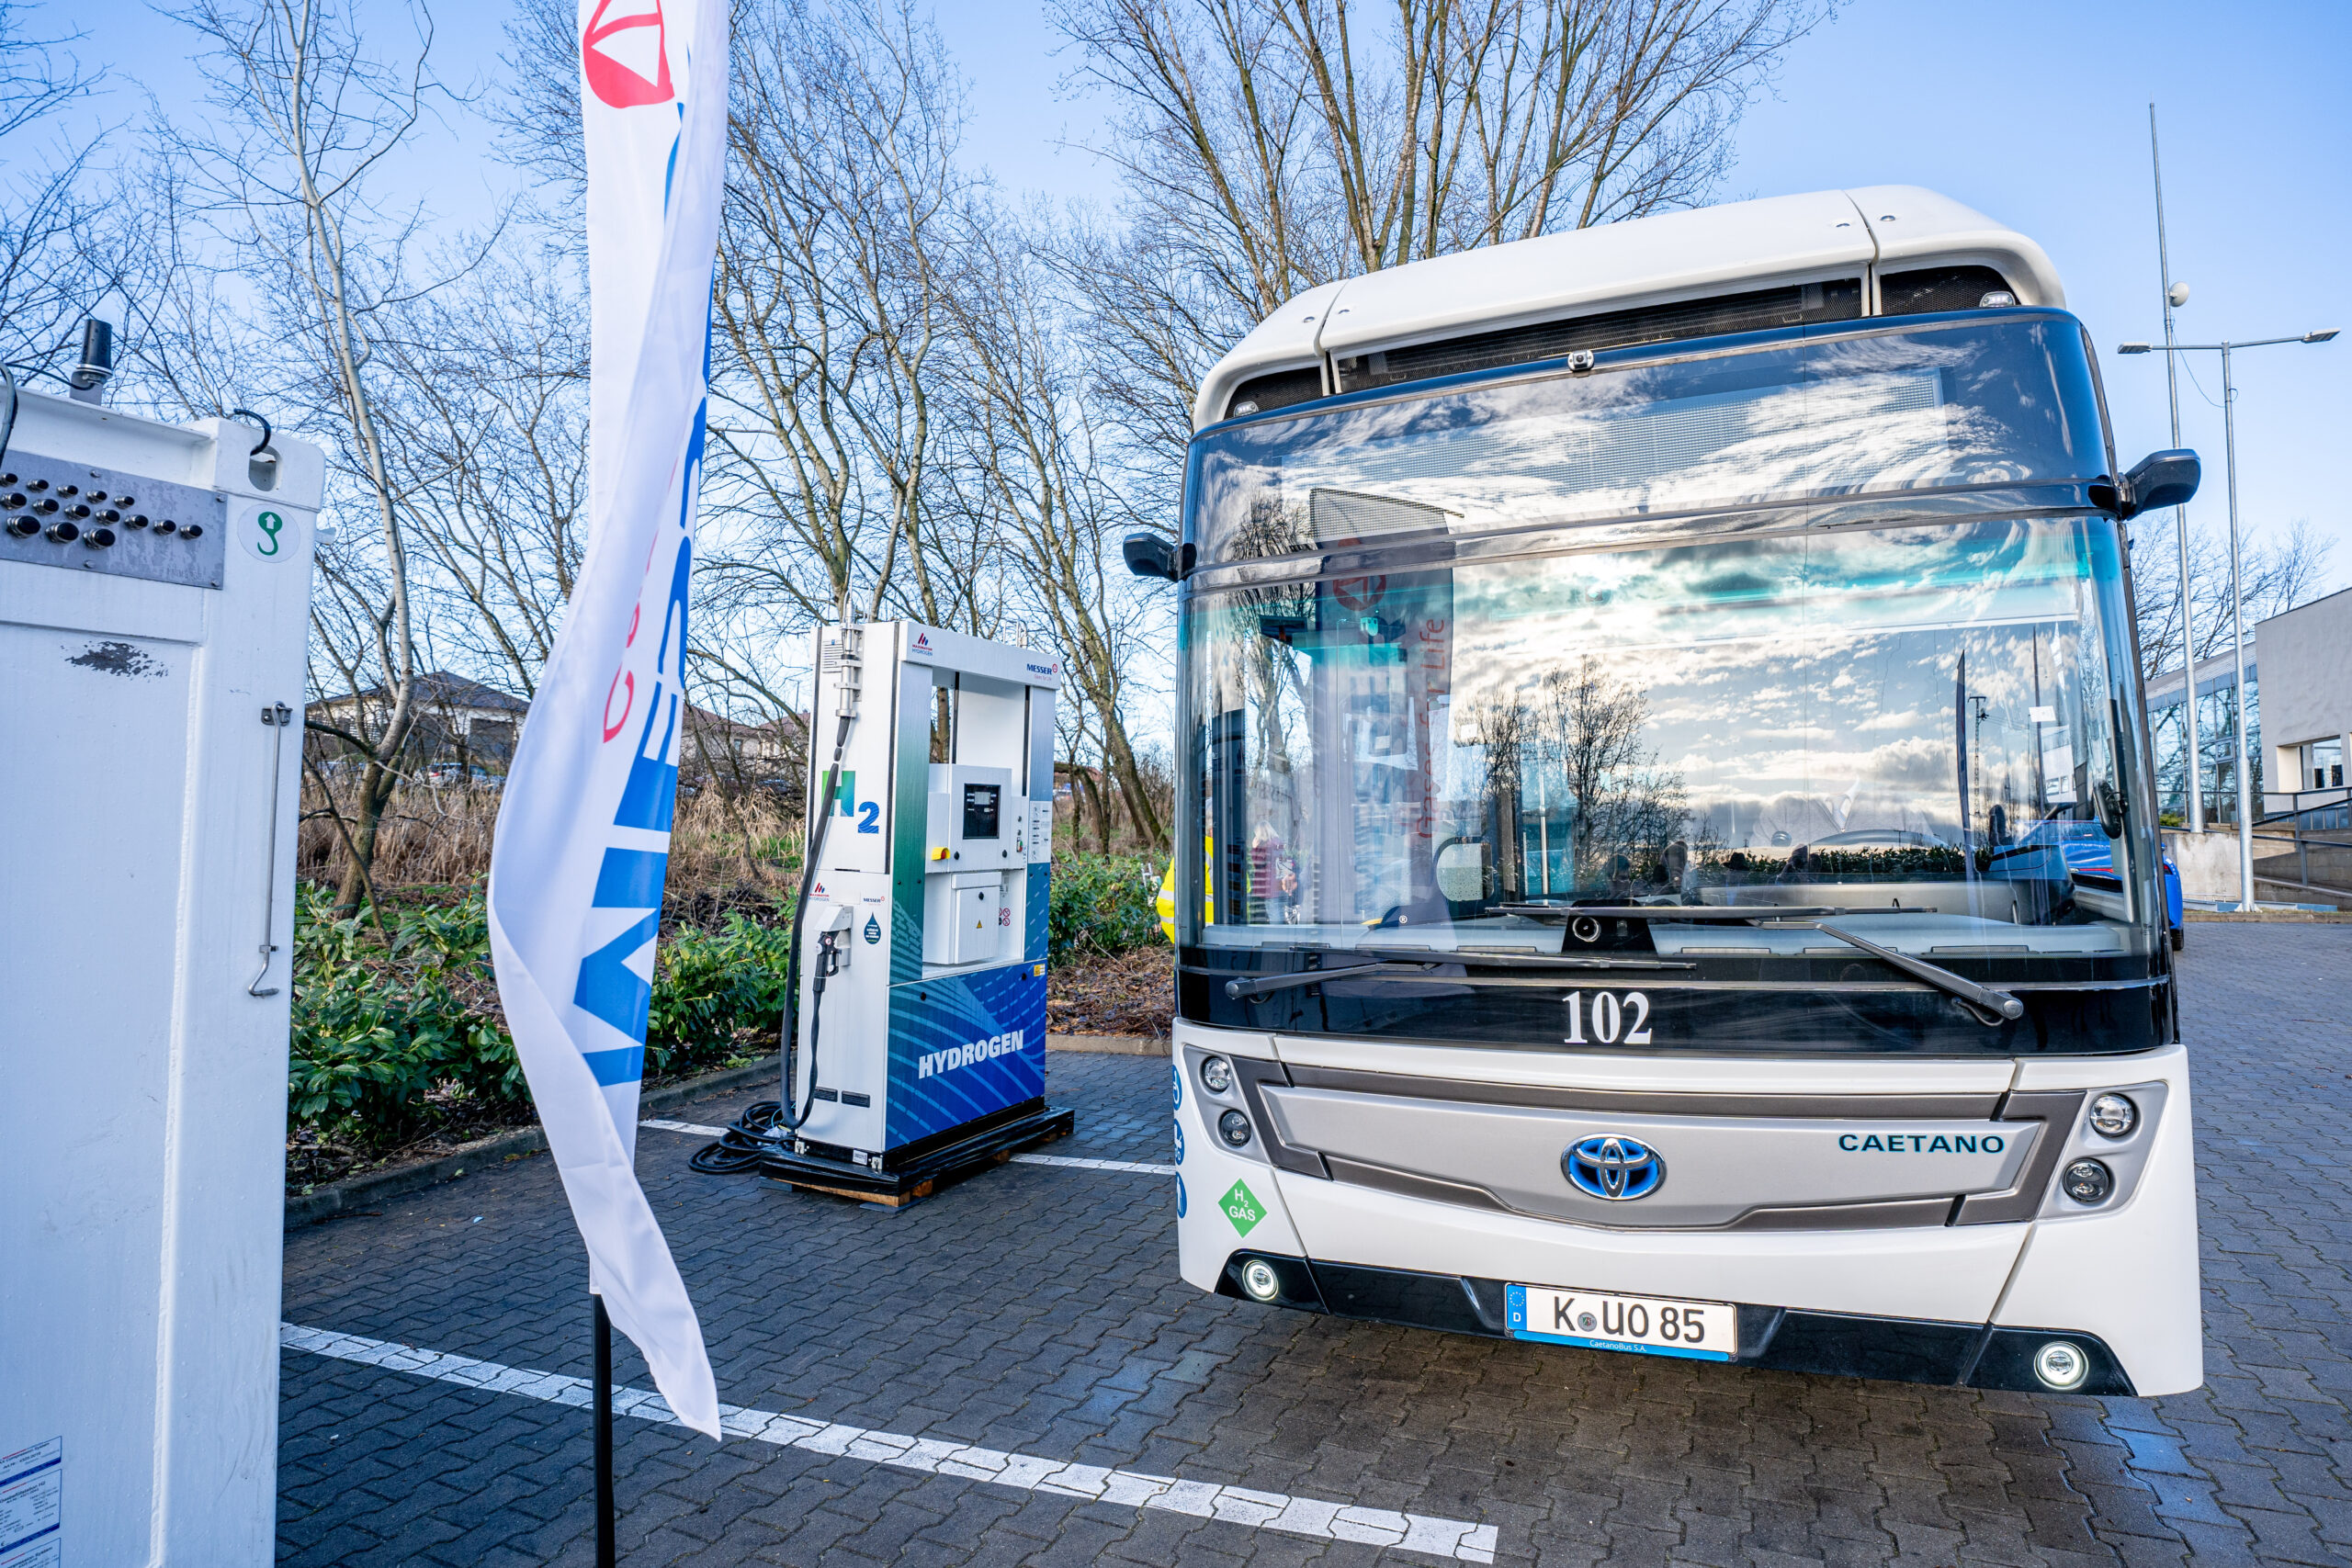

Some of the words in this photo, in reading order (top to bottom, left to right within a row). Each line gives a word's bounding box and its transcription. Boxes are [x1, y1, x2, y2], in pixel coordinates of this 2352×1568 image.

[1419, 618, 1445, 670] Life
[1026, 663, 1053, 676] MESSER
[1562, 990, 1653, 1045] 102
[918, 1029, 1024, 1079] HYDROGEN
[1838, 1134, 2006, 1155] CAETANO
[1228, 1205, 1256, 1222] GAS
[1512, 1312, 1521, 1323] D
[1554, 1296, 1576, 1331] K
[1602, 1301, 1649, 1337] UO
[1659, 1306, 1705, 1344] 85
[1589, 1339, 1633, 1351] CaetanoBus
[1634, 1344, 1647, 1352] S.A.
